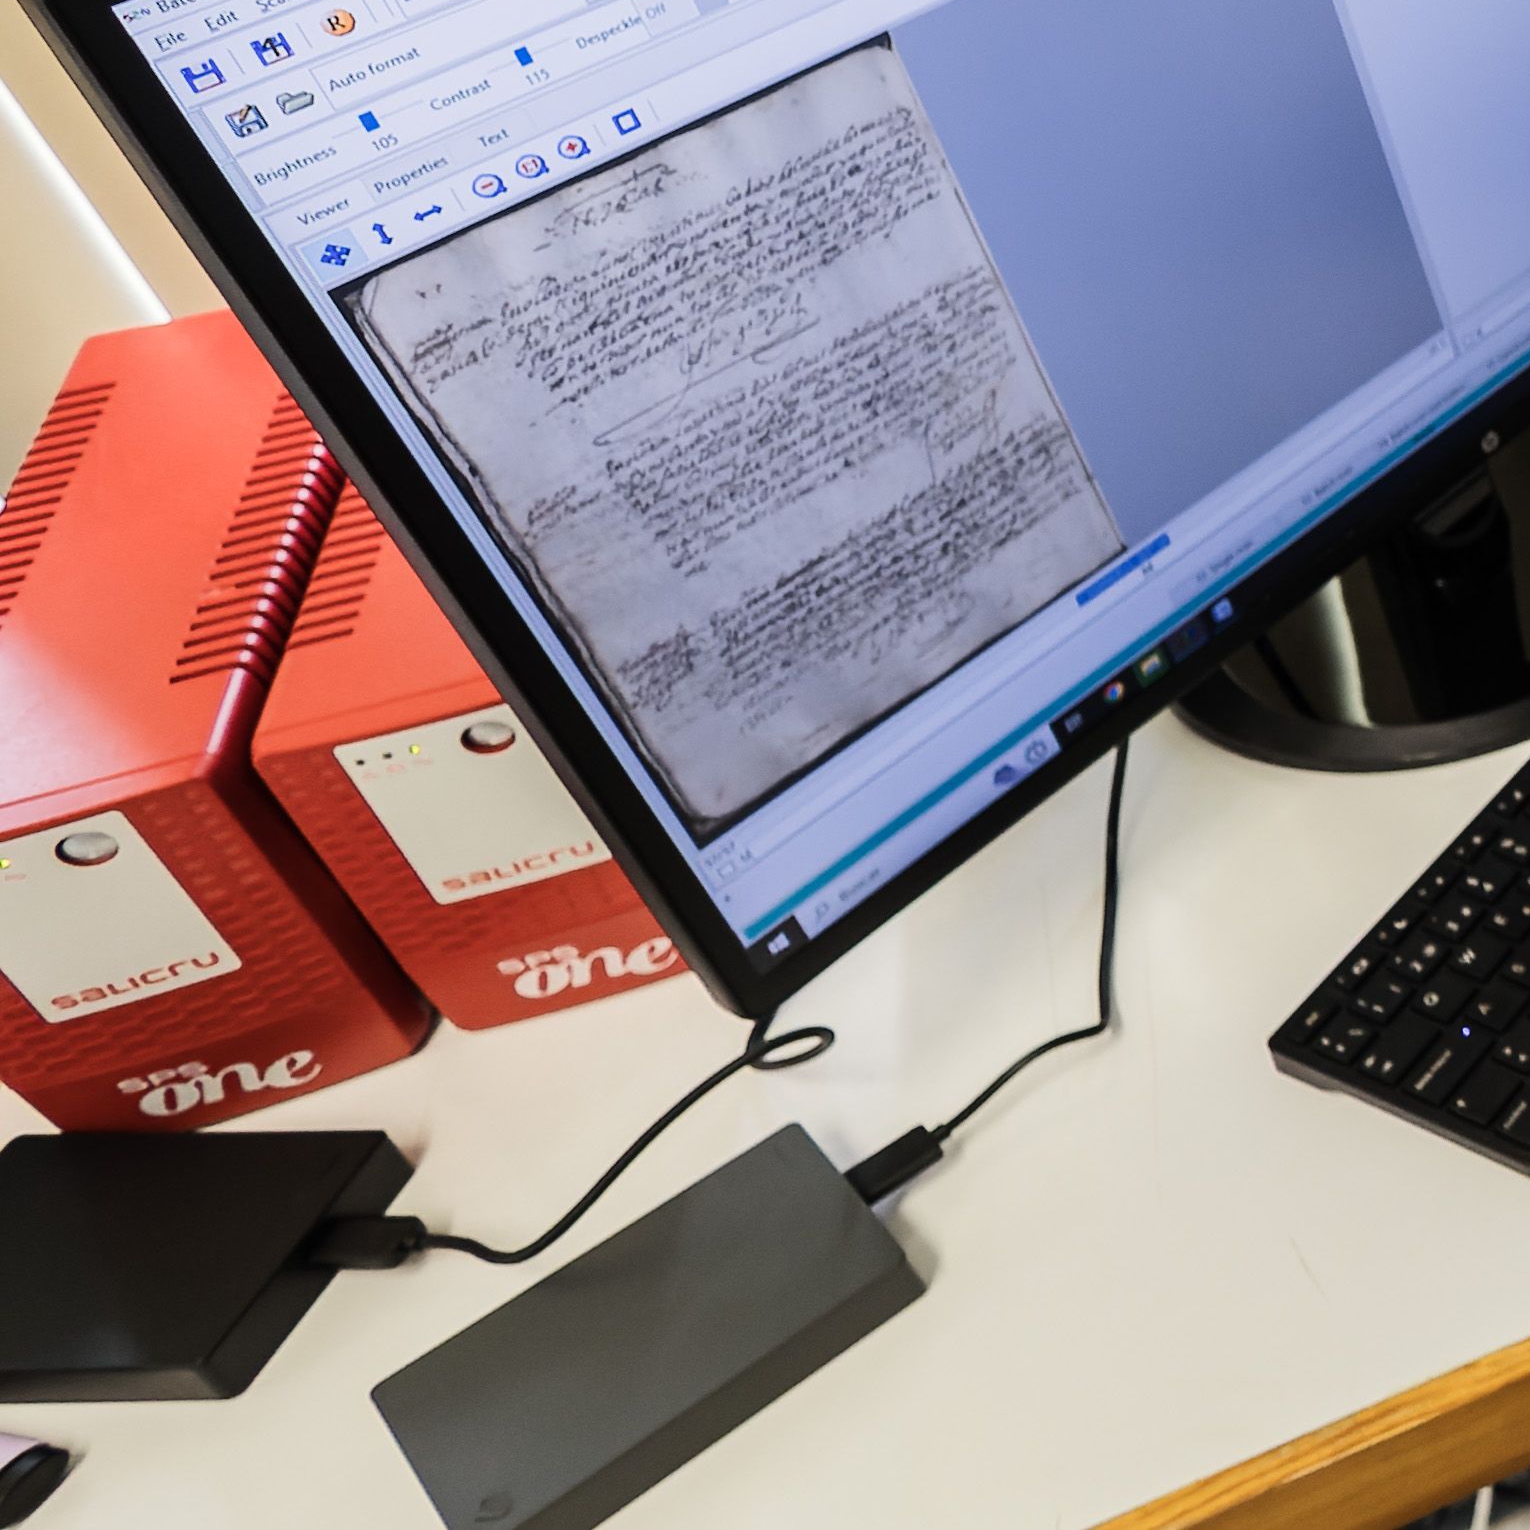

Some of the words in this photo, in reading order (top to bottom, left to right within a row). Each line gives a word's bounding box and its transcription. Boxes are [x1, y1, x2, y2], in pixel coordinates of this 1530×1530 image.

[154, 29, 188, 52] File
[204, 10, 239, 32] Edit
[575, 15, 642, 51] Despeckle
[327, 68, 367, 93] Auto
[368, 47, 422, 75] format
[430, 78, 492, 111] Contrast
[372, 133, 399, 152] 105
[477, 128, 510, 149] Text
[253, 146, 338, 187] Brightness
[373, 156, 449, 193] Properties
[296, 197, 351, 226] Viewer
[50, 951, 220, 1010] salicru
[513, 936, 679, 999] one
[138, 1049, 324, 1118] one
